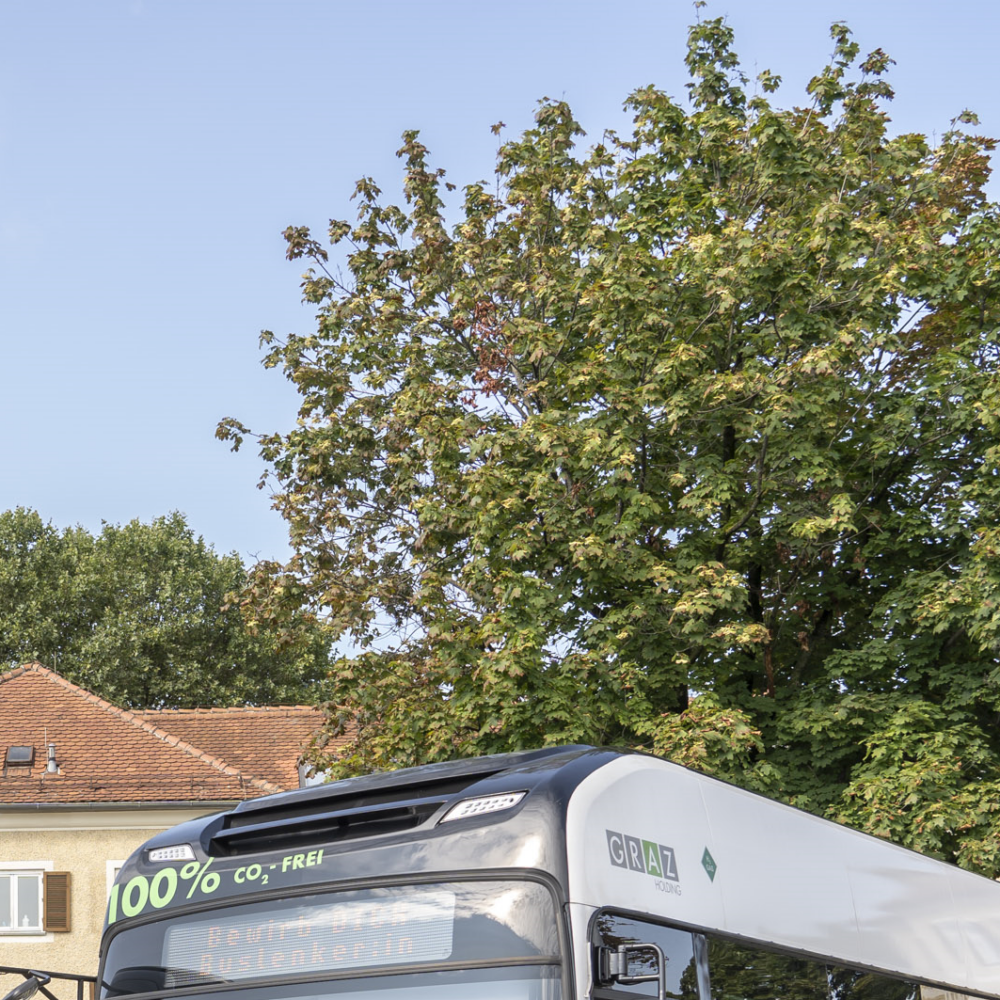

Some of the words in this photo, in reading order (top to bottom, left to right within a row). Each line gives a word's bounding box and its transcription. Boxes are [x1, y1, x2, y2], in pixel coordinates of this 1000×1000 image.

[607, 831, 678, 880] GRAZ
[108, 857, 221, 925] 100%
[654, 879, 682, 896] HOLDING
